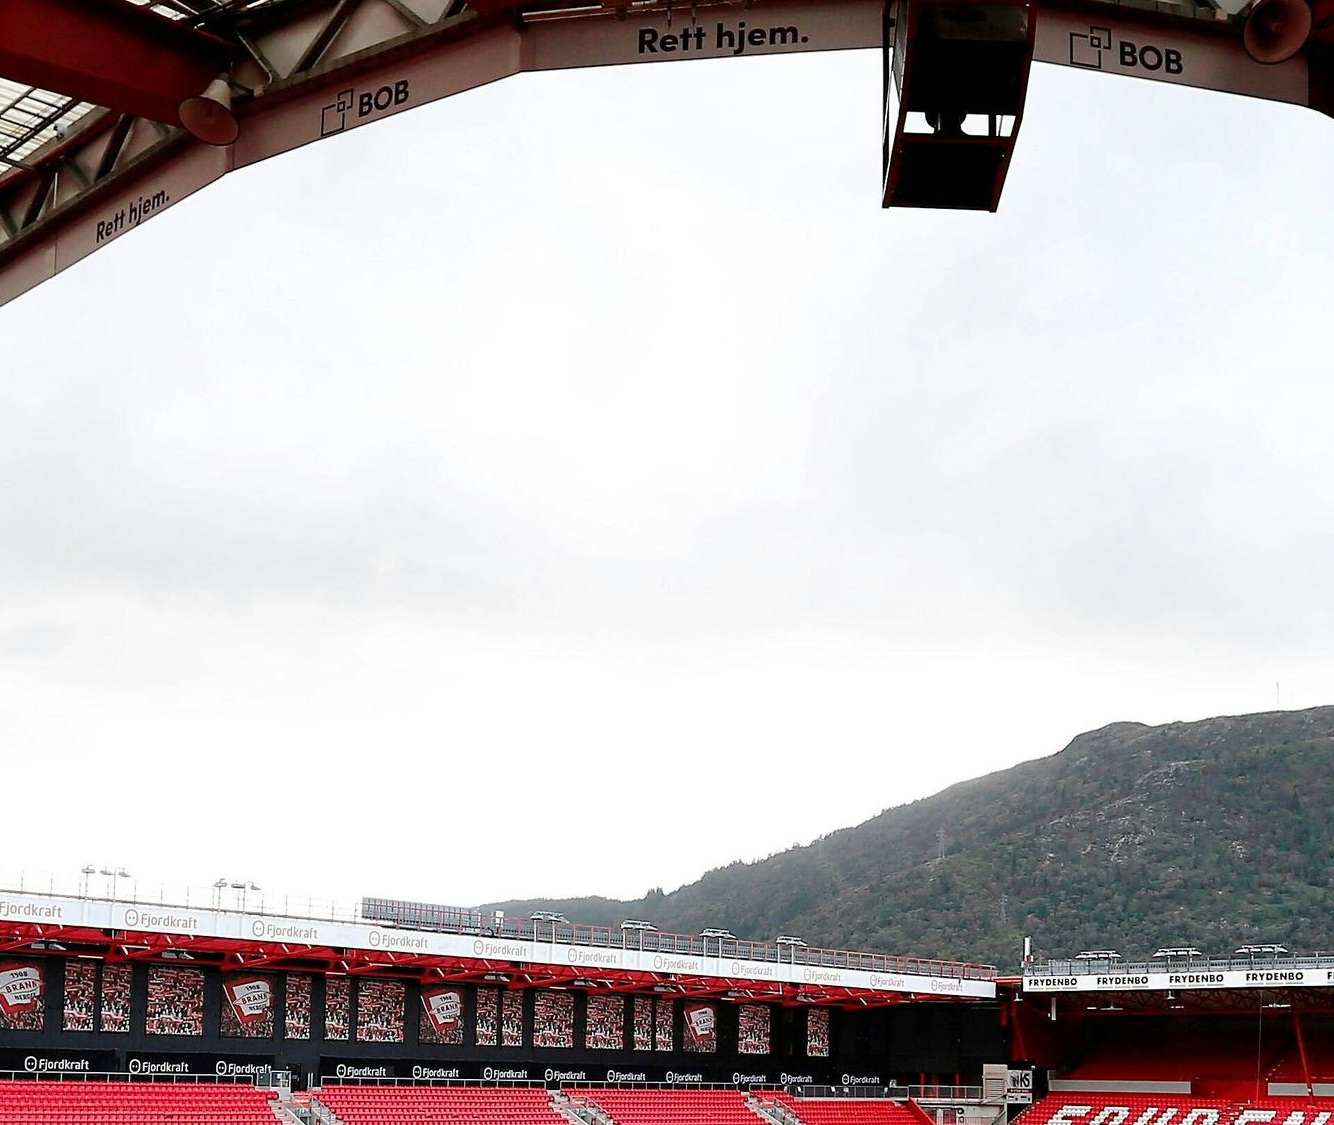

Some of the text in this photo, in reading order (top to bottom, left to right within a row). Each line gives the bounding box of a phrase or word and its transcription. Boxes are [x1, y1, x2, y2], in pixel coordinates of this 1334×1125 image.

[638, 21, 809, 55] Rett hjem.
[1120, 41, 1183, 74] BOB
[359, 80, 409, 118] BOB
[96, 189, 170, 243] Rett hjem.
[141, 912, 198, 930] Fjordkraft
[267, 923, 318, 940] Fjordkraft
[381, 933, 428, 949] Fjordkraft
[484, 942, 528, 958] Fjordkraft
[577, 949, 617, 965] Fjordkraft
[663, 958, 699, 972] Fjordkraft
[1028, 977, 1078, 987] FRYDENBØ
[1097, 976, 1149, 986] FRYDENBØ
[1169, 973, 1224, 984] FRYDENBØ
[1246, 971, 1304, 982] FRYDENBØ
[38, 1058, 89, 1072] Fjordkraft
[142, 1060, 189, 1074] Fjordkraft
[347, 1066, 386, 1078] Fjordkraft
[423, 1067, 459, 1079] Fjordkraft
[493, 1068, 528, 1080] Fjordkraft
[554, 1069, 586, 1080] Fjordkraft
[615, 1072, 646, 1082] Fjordkraft
[673, 1073, 702, 1083] Fjordkraft
[740, 1074, 767, 1084] Fjordkraft
[787, 1074, 813, 1084] Fjordkraft
[849, 1075, 880, 1085] Fjordkraft
